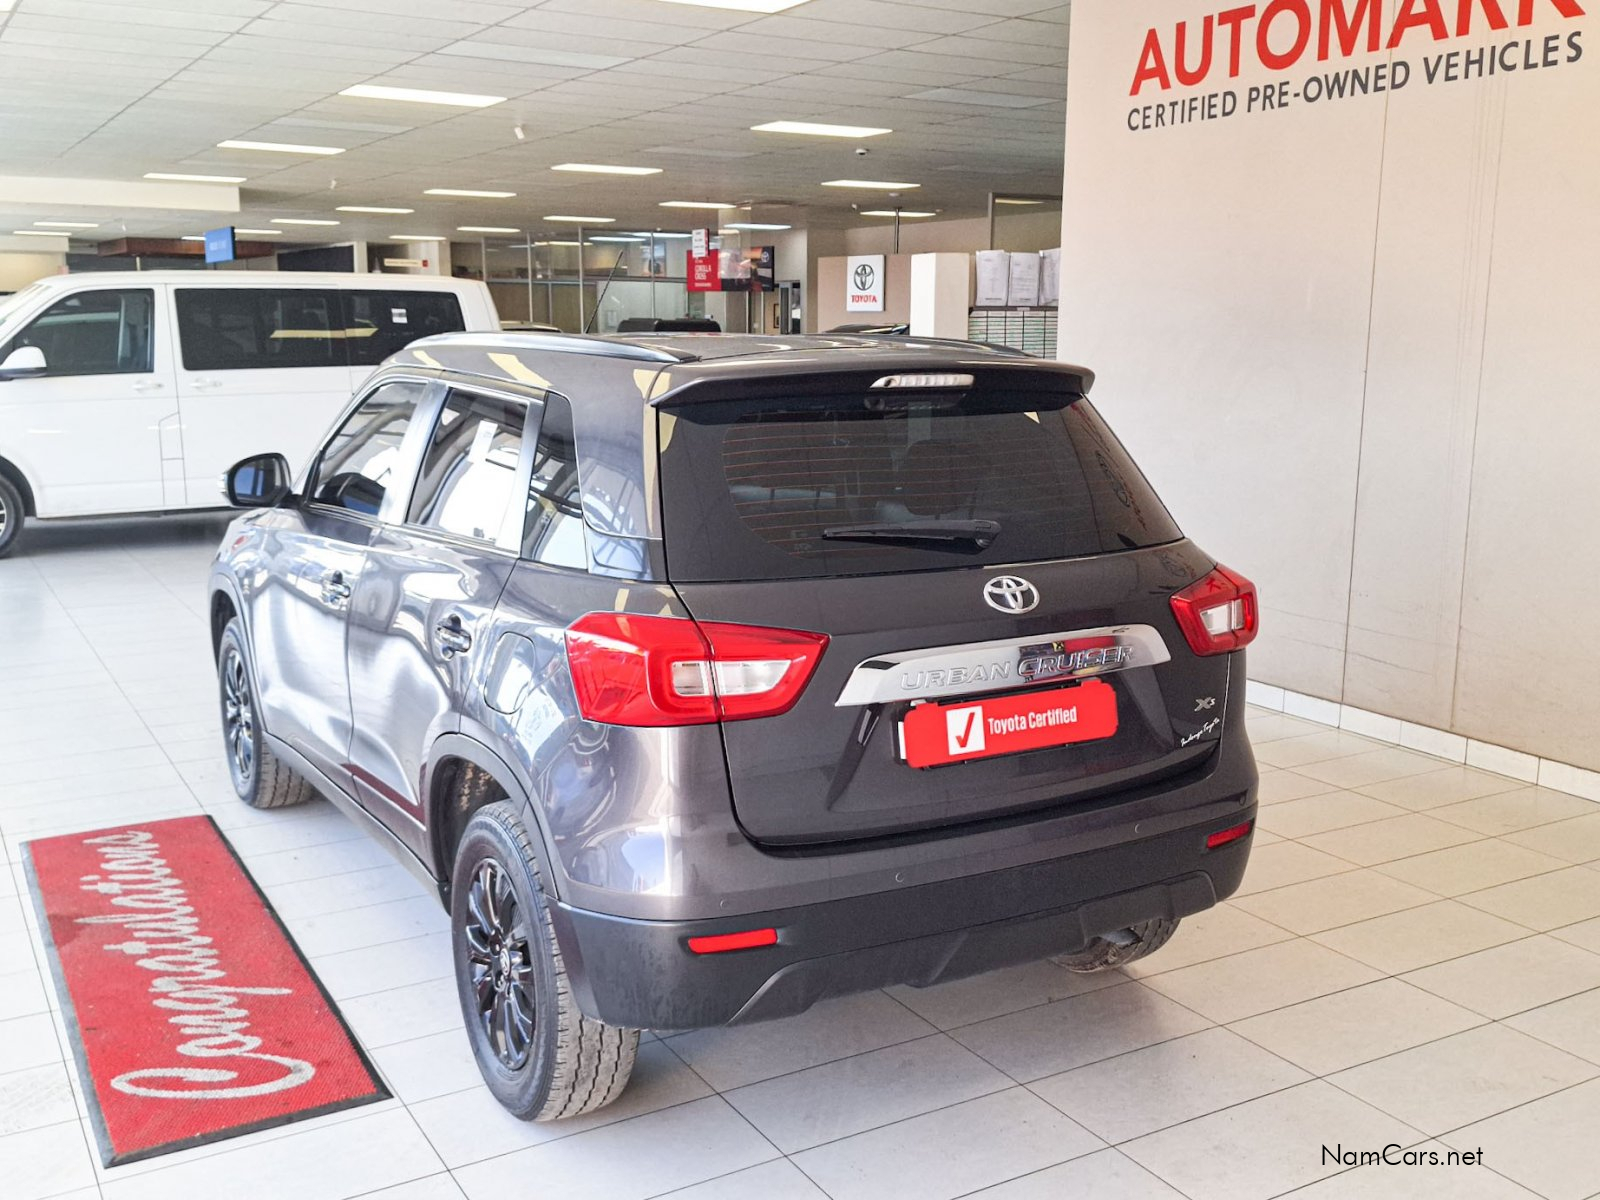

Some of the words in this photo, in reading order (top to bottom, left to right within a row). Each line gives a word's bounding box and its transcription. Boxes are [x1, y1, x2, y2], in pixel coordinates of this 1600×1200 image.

[1127, 90, 1238, 132] CERTIFIED
[1246, 60, 1411, 114] PRE-OWNED
[1423, 30, 1584, 85] VEHICLES
[851, 294, 878, 304] TOYOTA
[900, 660, 1012, 691] URBAN
[1017, 644, 1136, 677] CRUISER
[987, 713, 1026, 736] Toyota
[1028, 706, 1077, 729] Certified
[73, 830, 316, 1100] Congratulations
